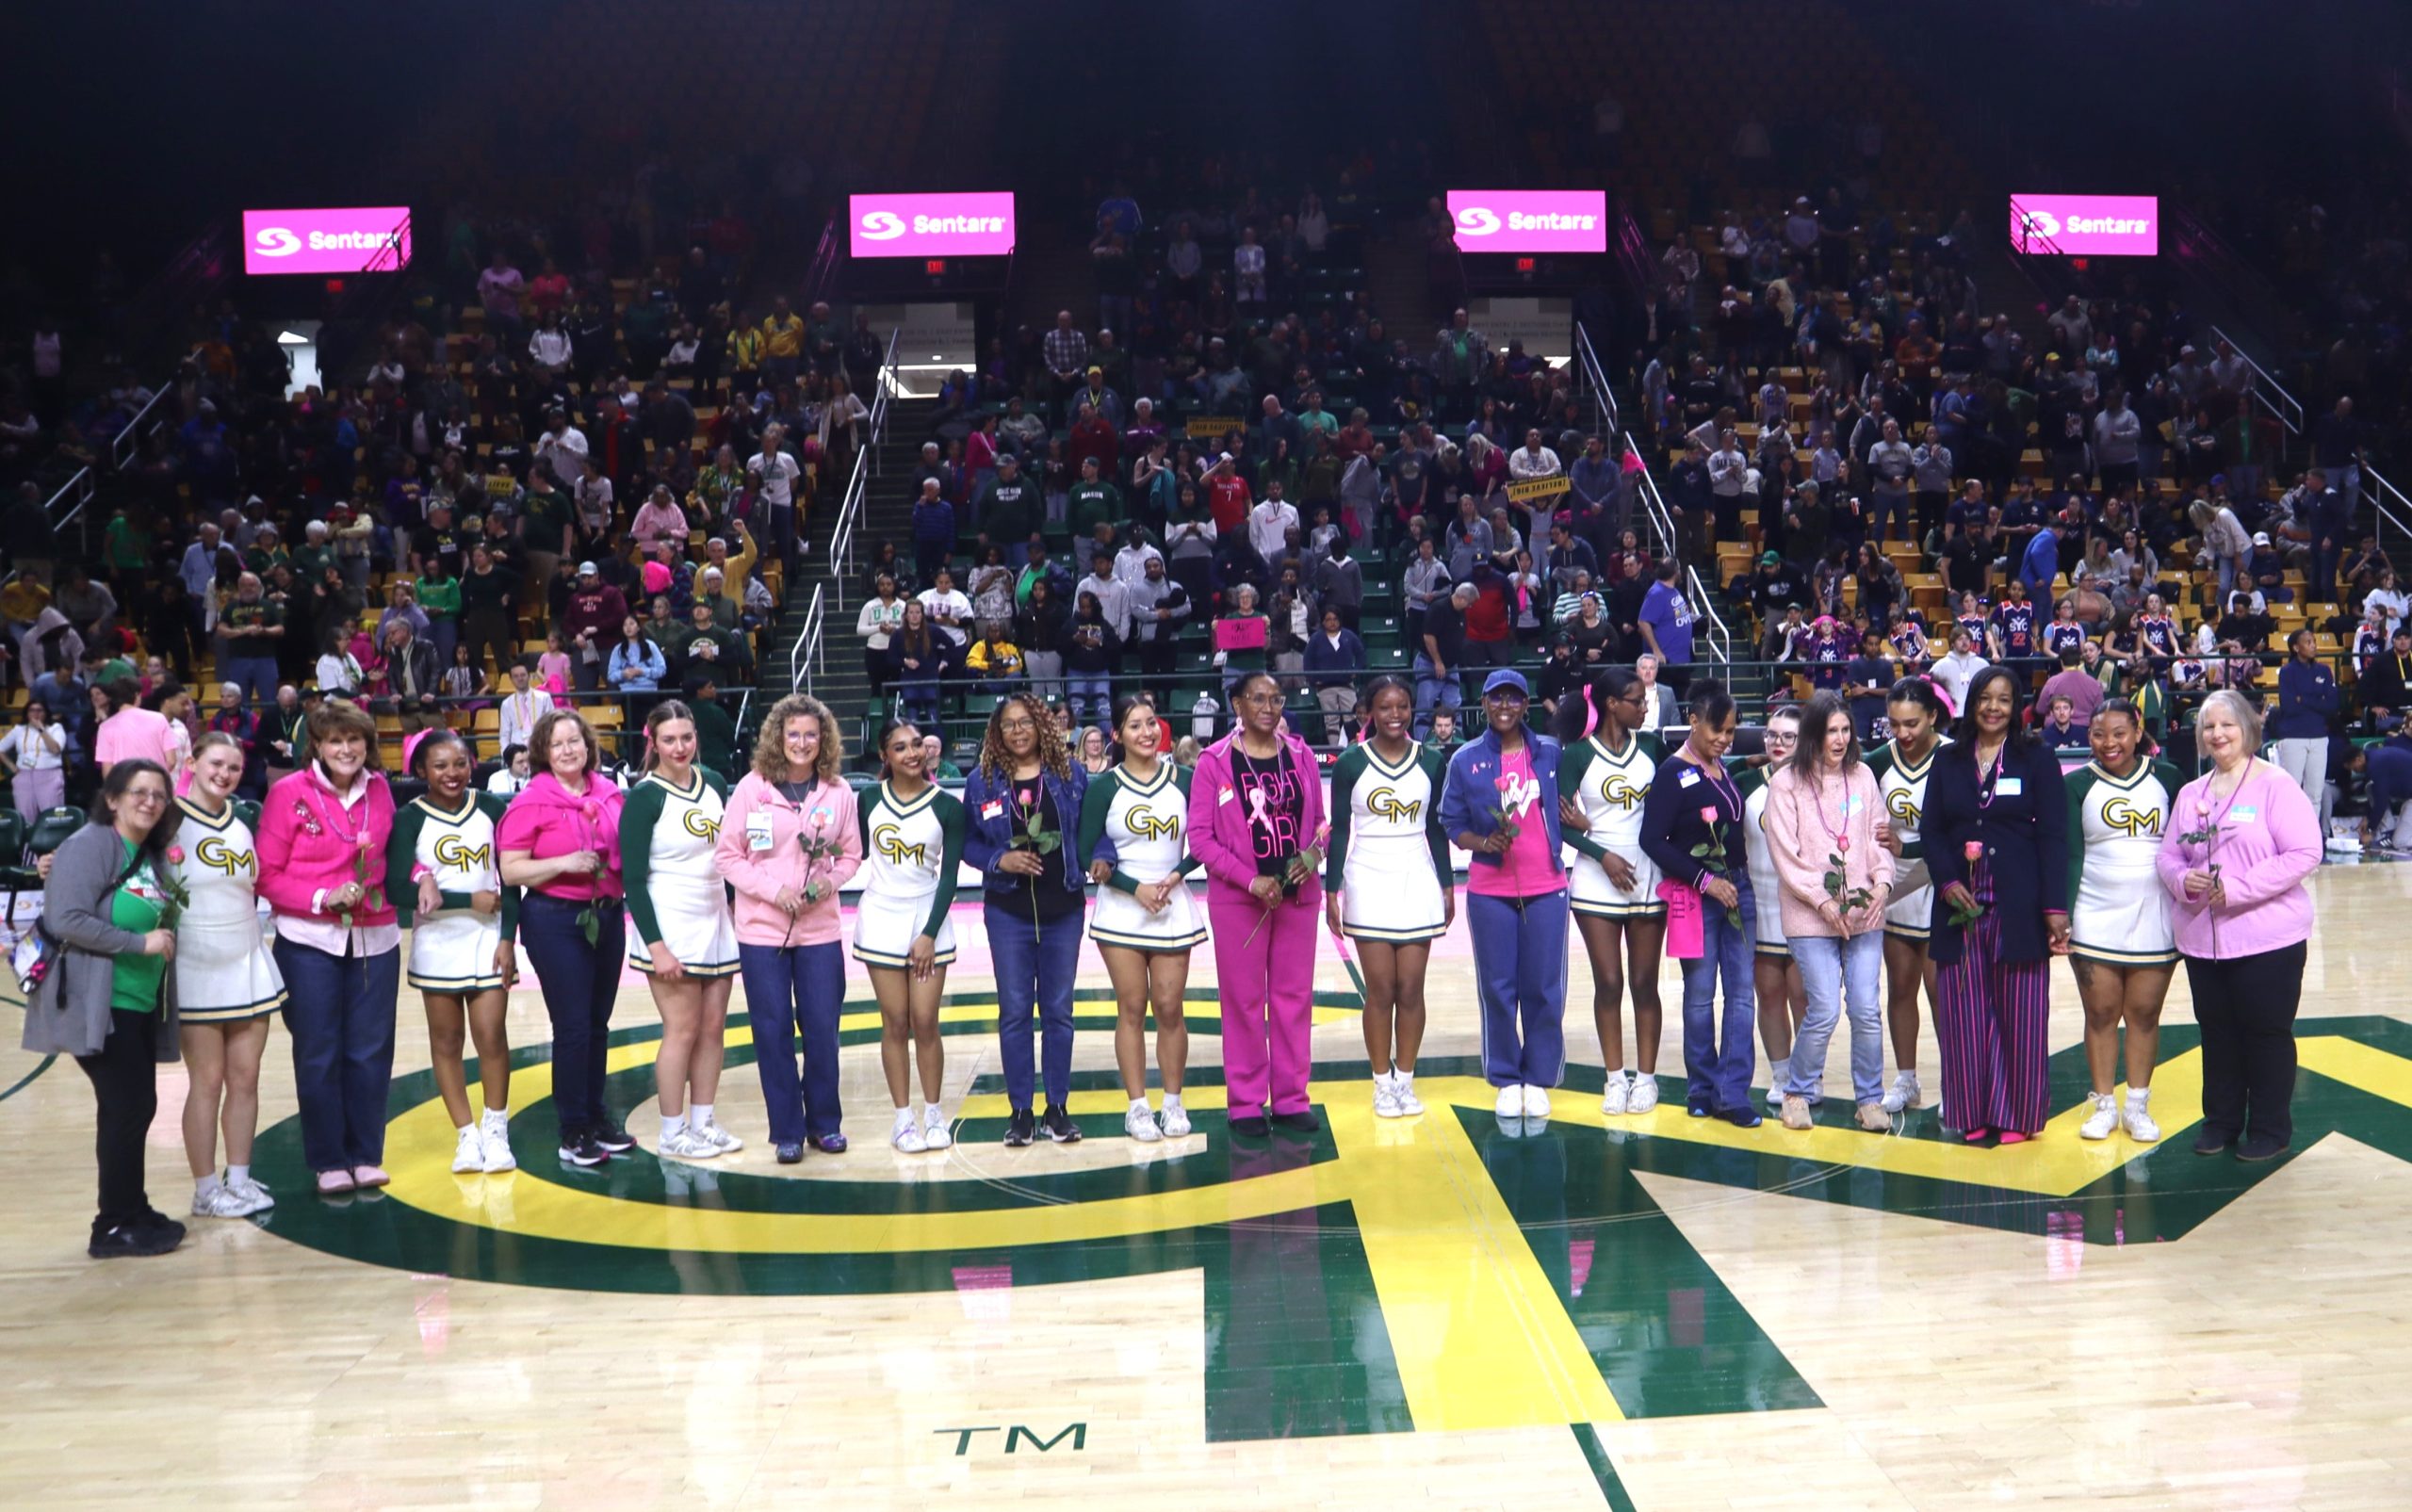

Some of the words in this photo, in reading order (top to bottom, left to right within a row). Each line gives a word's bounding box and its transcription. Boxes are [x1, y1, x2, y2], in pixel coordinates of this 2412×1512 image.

[914, 215, 1002, 234] Sentara
[1508, 212, 1594, 230] Sentara
[2067, 216, 2147, 234] Sentara
[1081, 491, 1103, 499] MASON
[1968, 626, 1982, 641] YC
[2009, 617, 2028, 632] SYC
[1366, 787, 1423, 823] GM
[2101, 797, 2160, 837] GM
[1125, 805, 1179, 841] GM
[196, 837, 256, 877] GM
[434, 835, 491, 873] GM
[872, 823, 926, 867] GM
[933, 1423, 1087, 1455] TM
